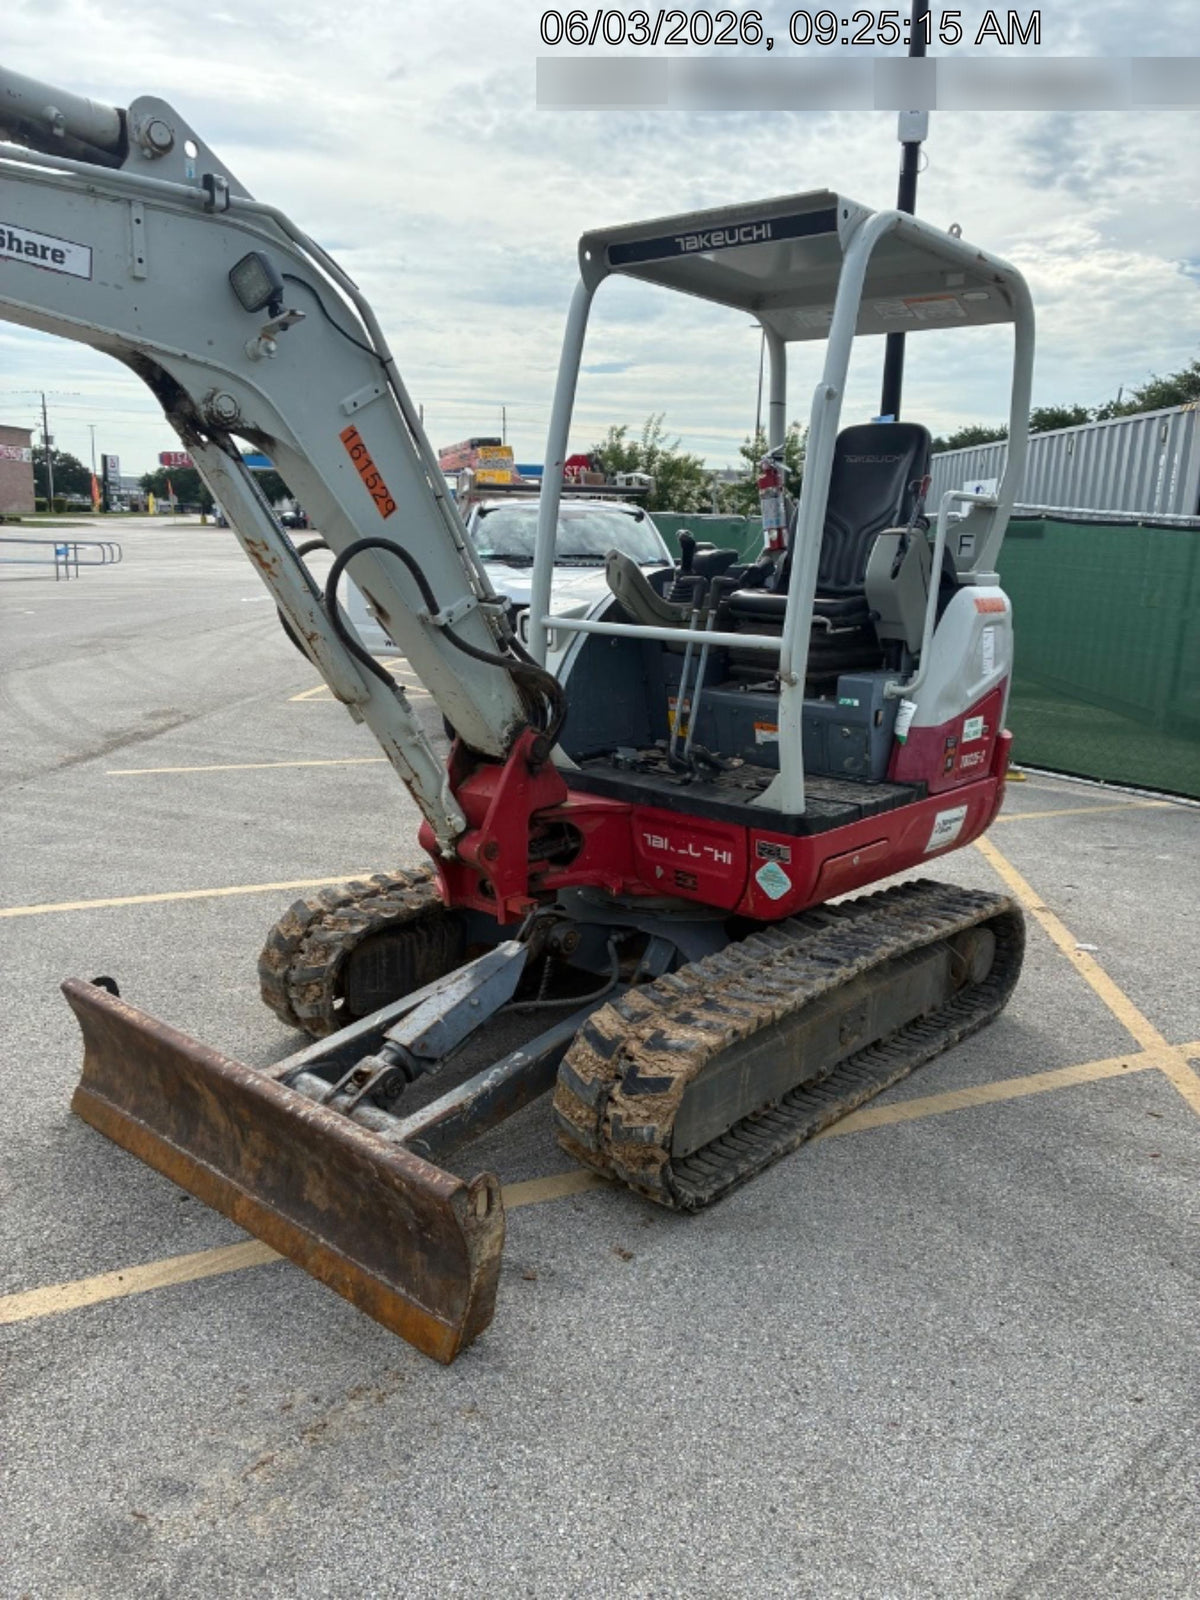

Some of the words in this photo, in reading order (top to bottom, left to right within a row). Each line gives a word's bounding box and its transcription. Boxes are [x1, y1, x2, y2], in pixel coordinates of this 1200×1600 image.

[674, 222, 773, 252] TAKEUCHI
[343, 429, 397, 519] 161529
[564, 465, 591, 477] STO
[957, 534, 975, 556] F
[642, 833, 732, 865] TAKUHI
